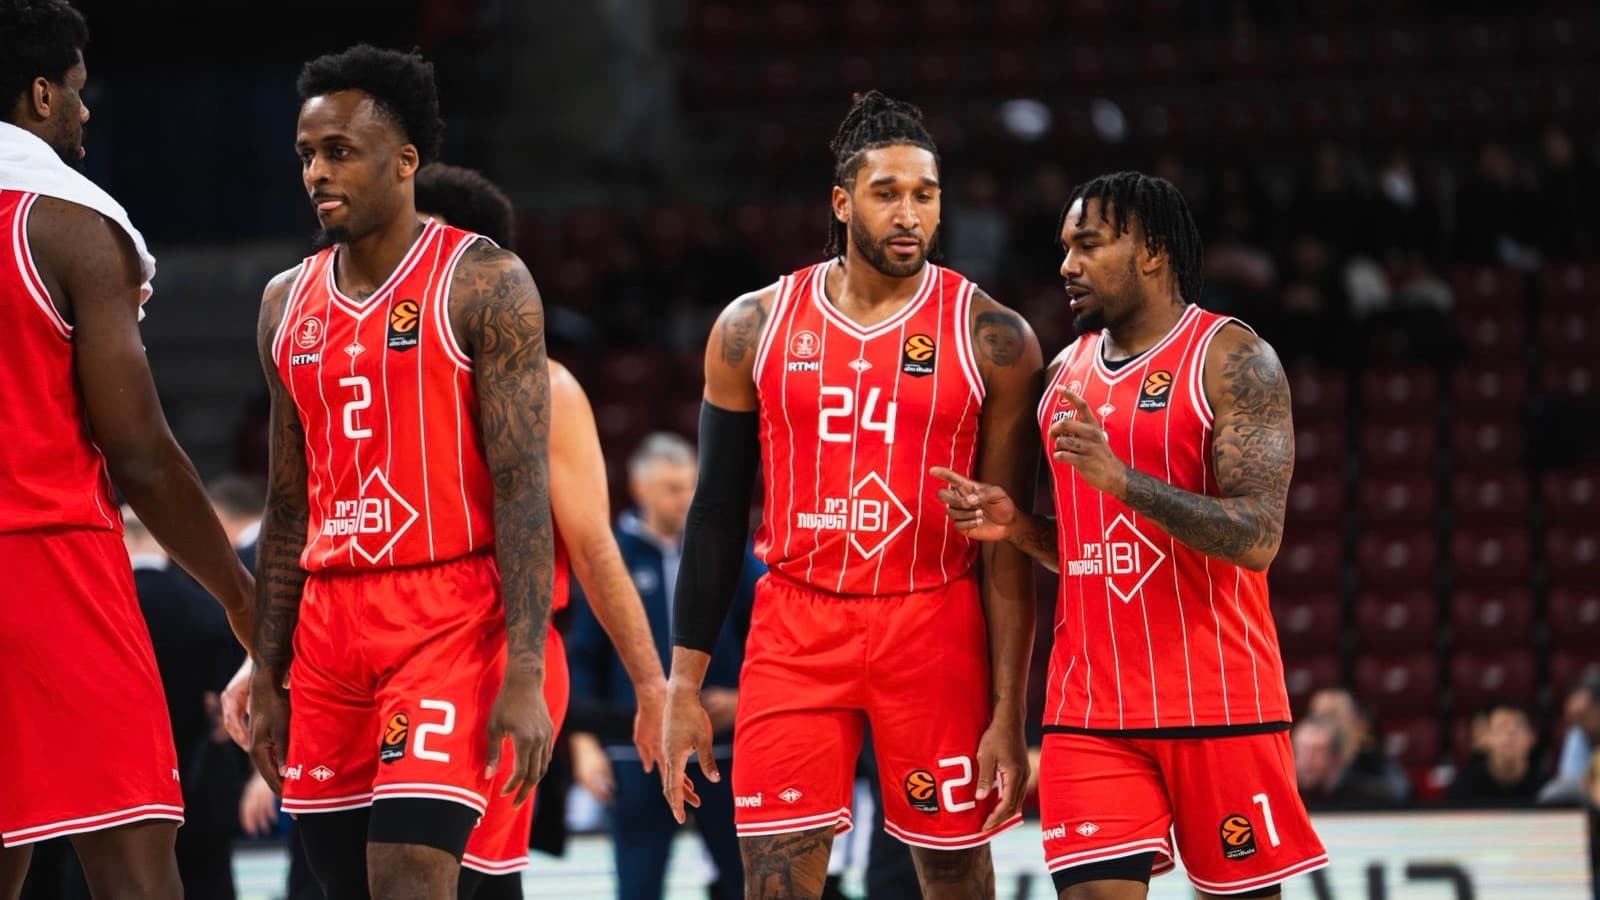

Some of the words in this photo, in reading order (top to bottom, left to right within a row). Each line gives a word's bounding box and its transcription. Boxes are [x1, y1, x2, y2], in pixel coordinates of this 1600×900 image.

[292, 353, 319, 366] RTMI
[787, 361, 819, 372] RTMI
[338, 375, 373, 440] 2
[818, 386, 898, 445] 24
[335, 500, 357, 517] בית
[825, 498, 848, 513] בית
[851, 498, 889, 532] IBI
[1083, 543, 1103, 558] בית
[1105, 541, 1141, 574] IBI
[413, 699, 456, 762] 2
[1252, 793, 1280, 848] 1
